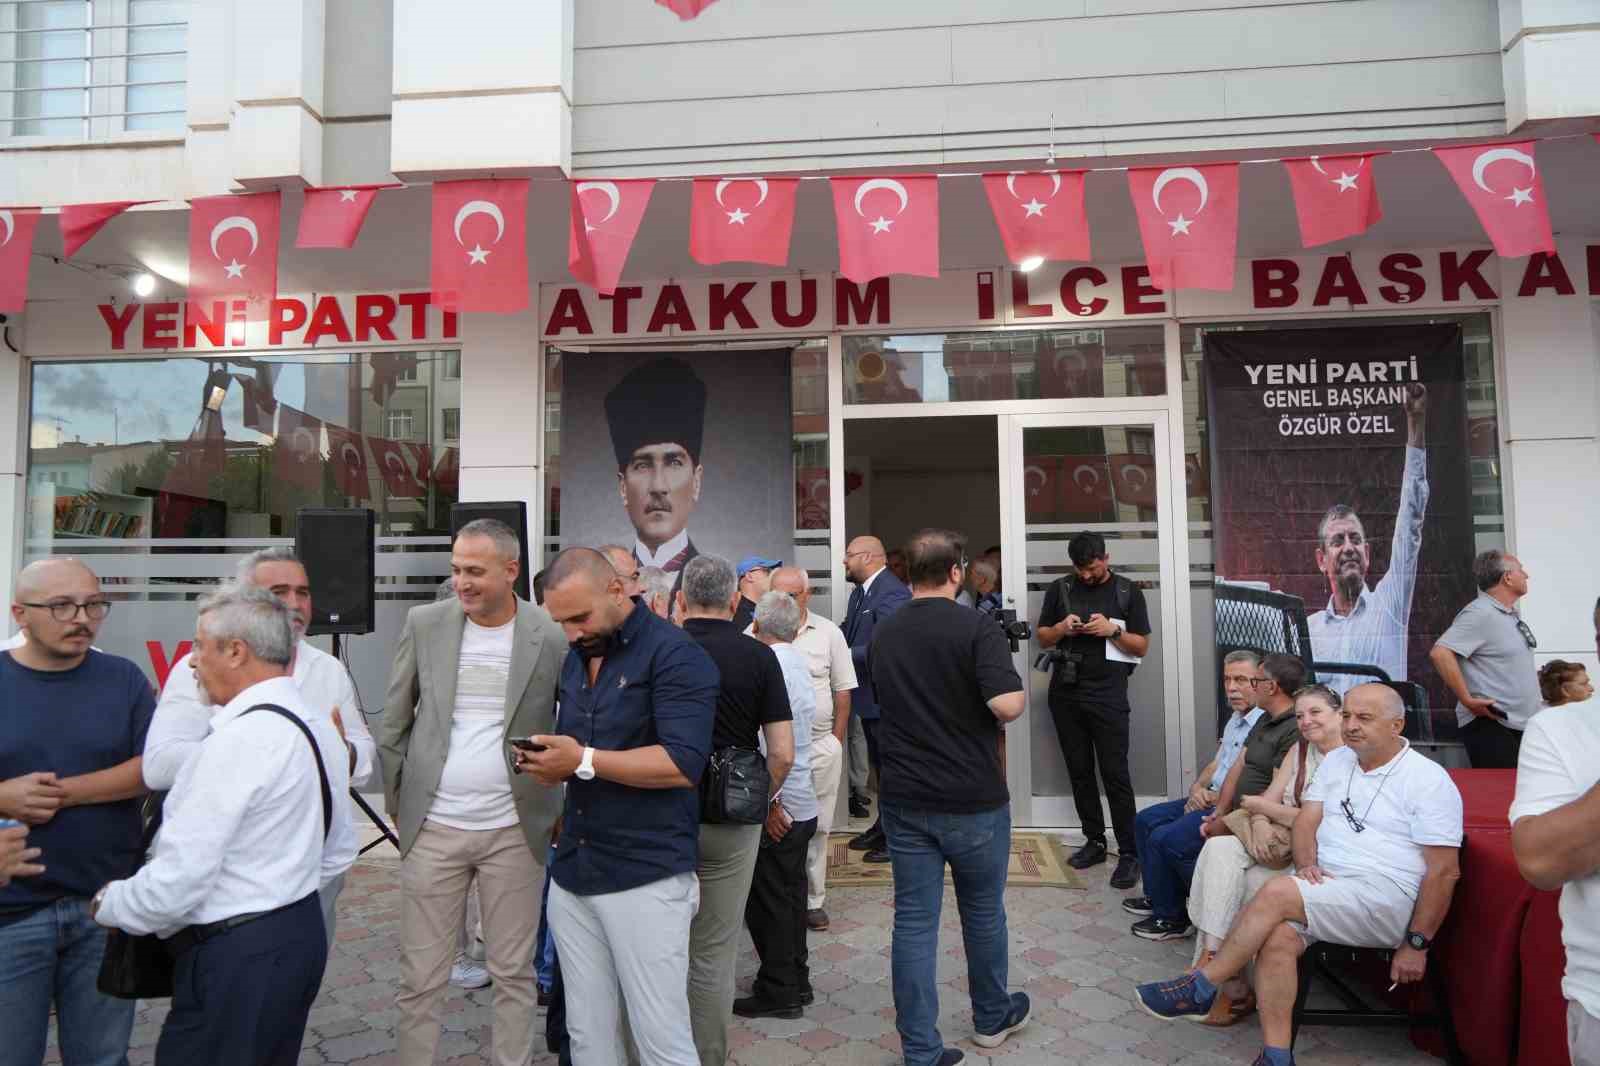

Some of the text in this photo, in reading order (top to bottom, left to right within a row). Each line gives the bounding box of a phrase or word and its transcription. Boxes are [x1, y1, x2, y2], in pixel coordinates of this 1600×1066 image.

[97, 301, 247, 349] YENİ
[545, 276, 890, 336] ATAKUM
[977, 265, 1166, 320] İLÇE
[1244, 355, 1418, 385] YENİ PARTİ
[1263, 386, 1407, 408] GENEL BAŞKANI
[1279, 411, 1395, 436] ÖZGÜR ÖZEL
